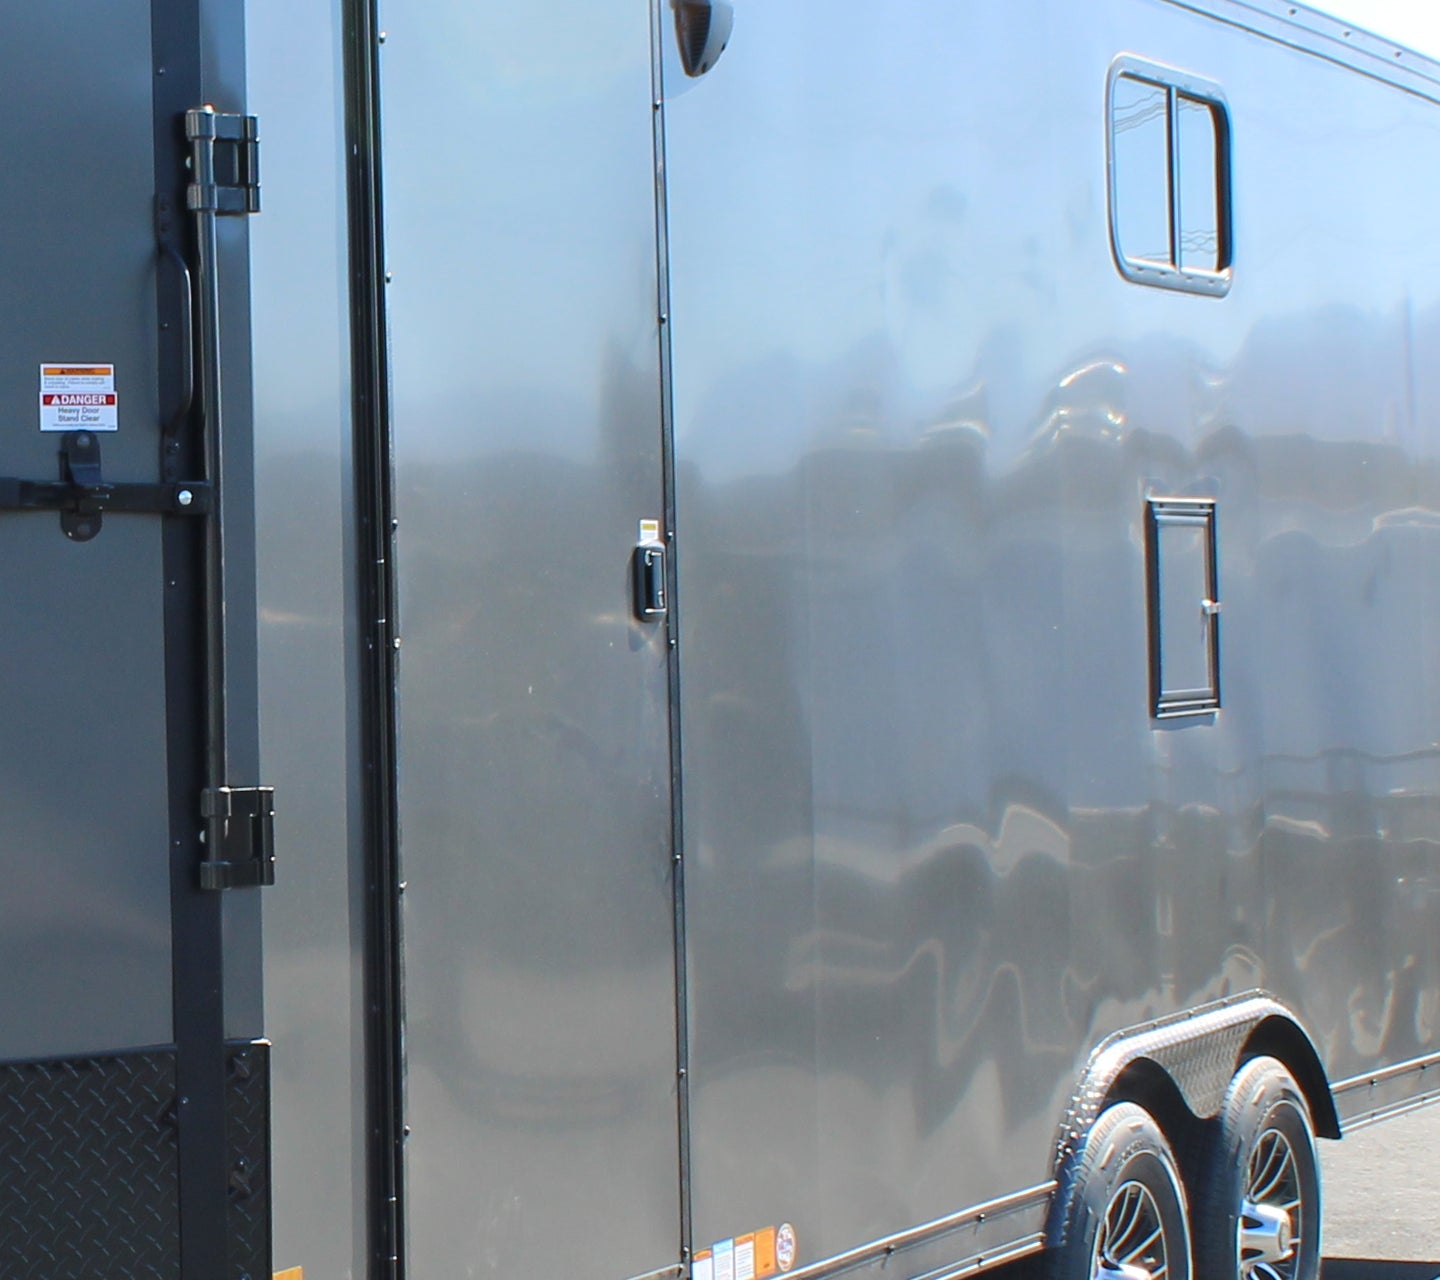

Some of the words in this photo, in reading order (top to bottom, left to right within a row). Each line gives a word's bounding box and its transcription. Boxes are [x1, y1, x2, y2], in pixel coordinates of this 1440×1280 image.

[60, 395, 107, 405] DANGER
[57, 406, 80, 416] Heavy
[81, 406, 100, 414] Door
[57, 414, 80, 422] Stand
[80, 414, 100, 422] Clear
